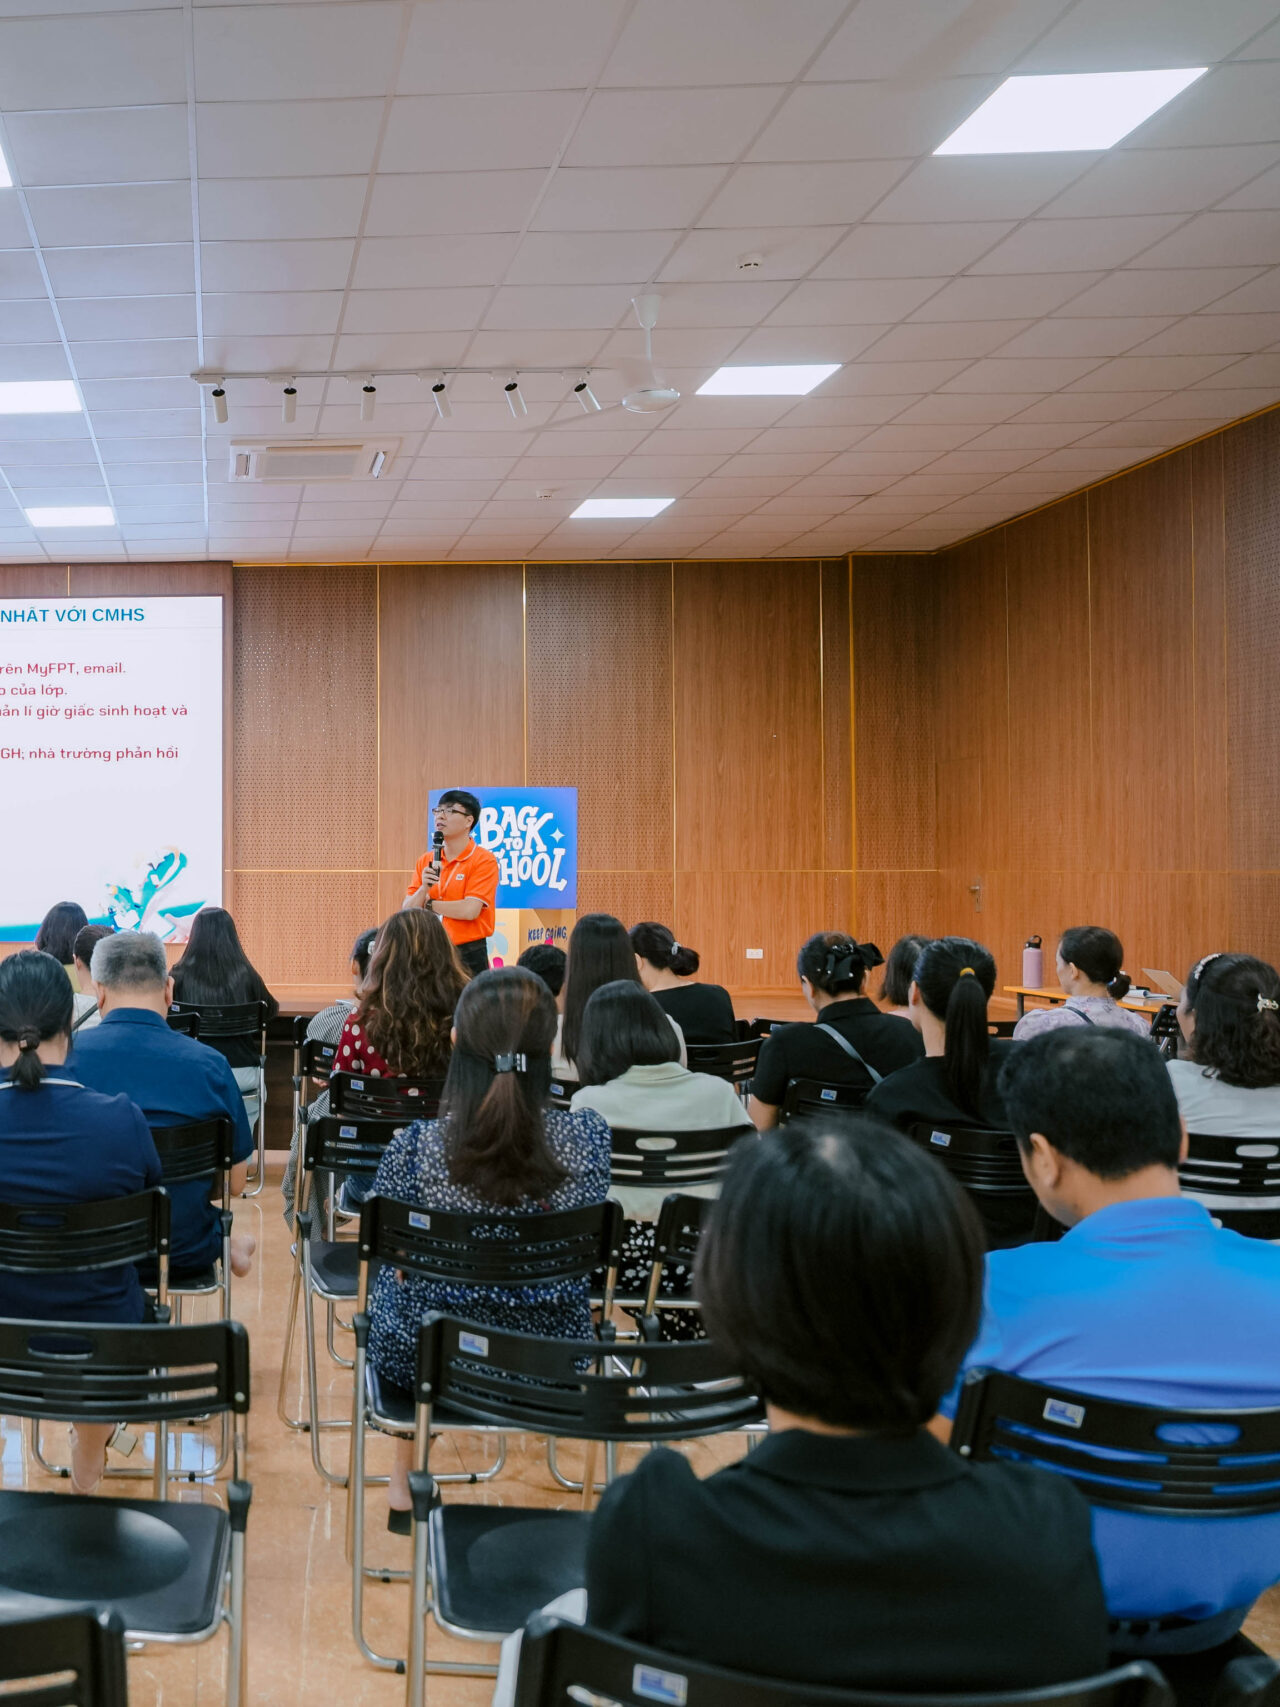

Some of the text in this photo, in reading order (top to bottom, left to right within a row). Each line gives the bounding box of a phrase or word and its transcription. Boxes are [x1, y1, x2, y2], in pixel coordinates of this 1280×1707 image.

[55, 605, 86, 622] VỚI
[92, 608, 145, 622] CMHS
[27, 662, 80, 678] MyFPT,
[83, 661, 126, 675] email.
[10, 682, 37, 696] của
[40, 683, 68, 699] lớp.
[24, 705, 33, 717] lí
[36, 704, 61, 721] giờ
[63, 703, 95, 721] giấc
[98, 704, 130, 717] sinh
[133, 704, 168, 719] hoạt
[171, 703, 188, 716] và
[28, 747, 56, 760] nhà
[59, 747, 112, 763] trường
[115, 745, 152, 763] phản
[478, 805, 554, 855] BACK
[503, 837, 523, 850] TO
[490, 847, 568, 891] HOOL
[527, 927, 544, 943] KEEP
